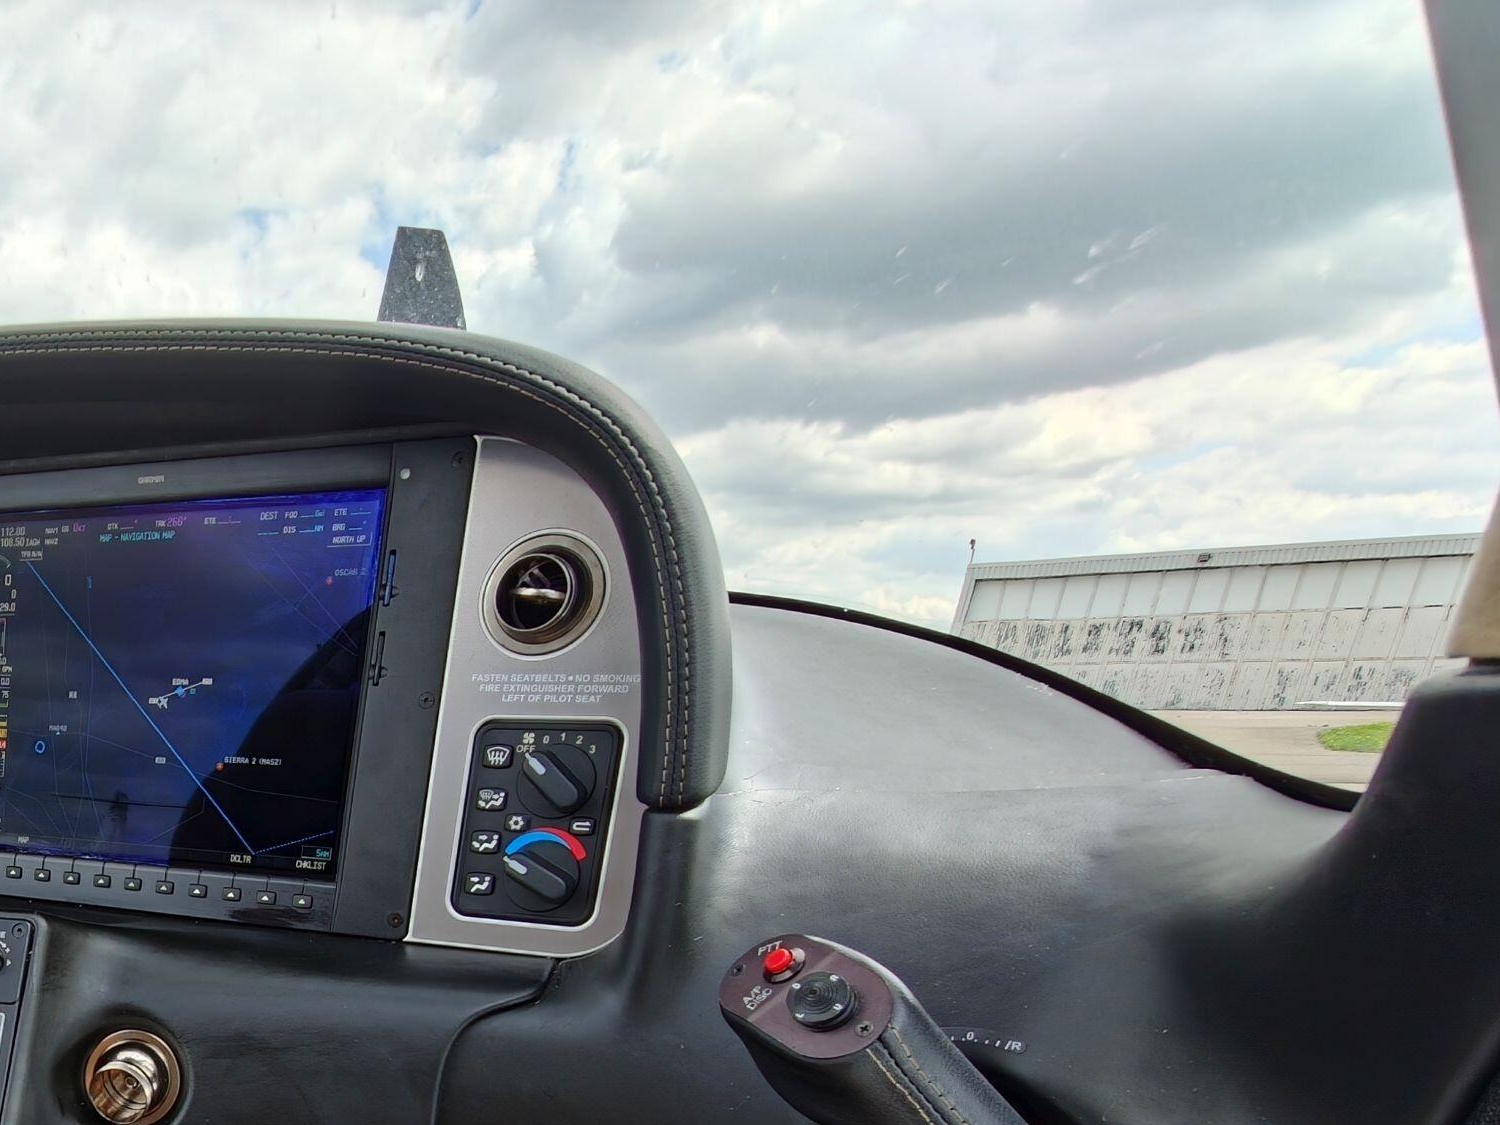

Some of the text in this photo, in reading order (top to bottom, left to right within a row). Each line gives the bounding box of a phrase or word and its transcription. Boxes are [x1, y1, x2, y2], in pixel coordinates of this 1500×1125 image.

[99, 530, 176, 542] MAP NAVIGATION MAP
[332, 535, 366, 544] NORTH UP
[0, 602, 16, 612] 29.0
[471, 673, 642, 683] FASTEN SEATBELTS NO SMOKING
[479, 683, 629, 694] FIRE EXTINGUISHER FORWARD
[501, 694, 602, 703] LEFT OF PILOT SEAT
[542, 732, 597, 754] 0 1 2 3
[516, 744, 536, 753] OFF
[224, 757, 250, 765] SIERRA
[230, 854, 252, 864] DCLTR
[295, 860, 327, 871] CHKLIST
[757, 940, 782, 956] PTT
